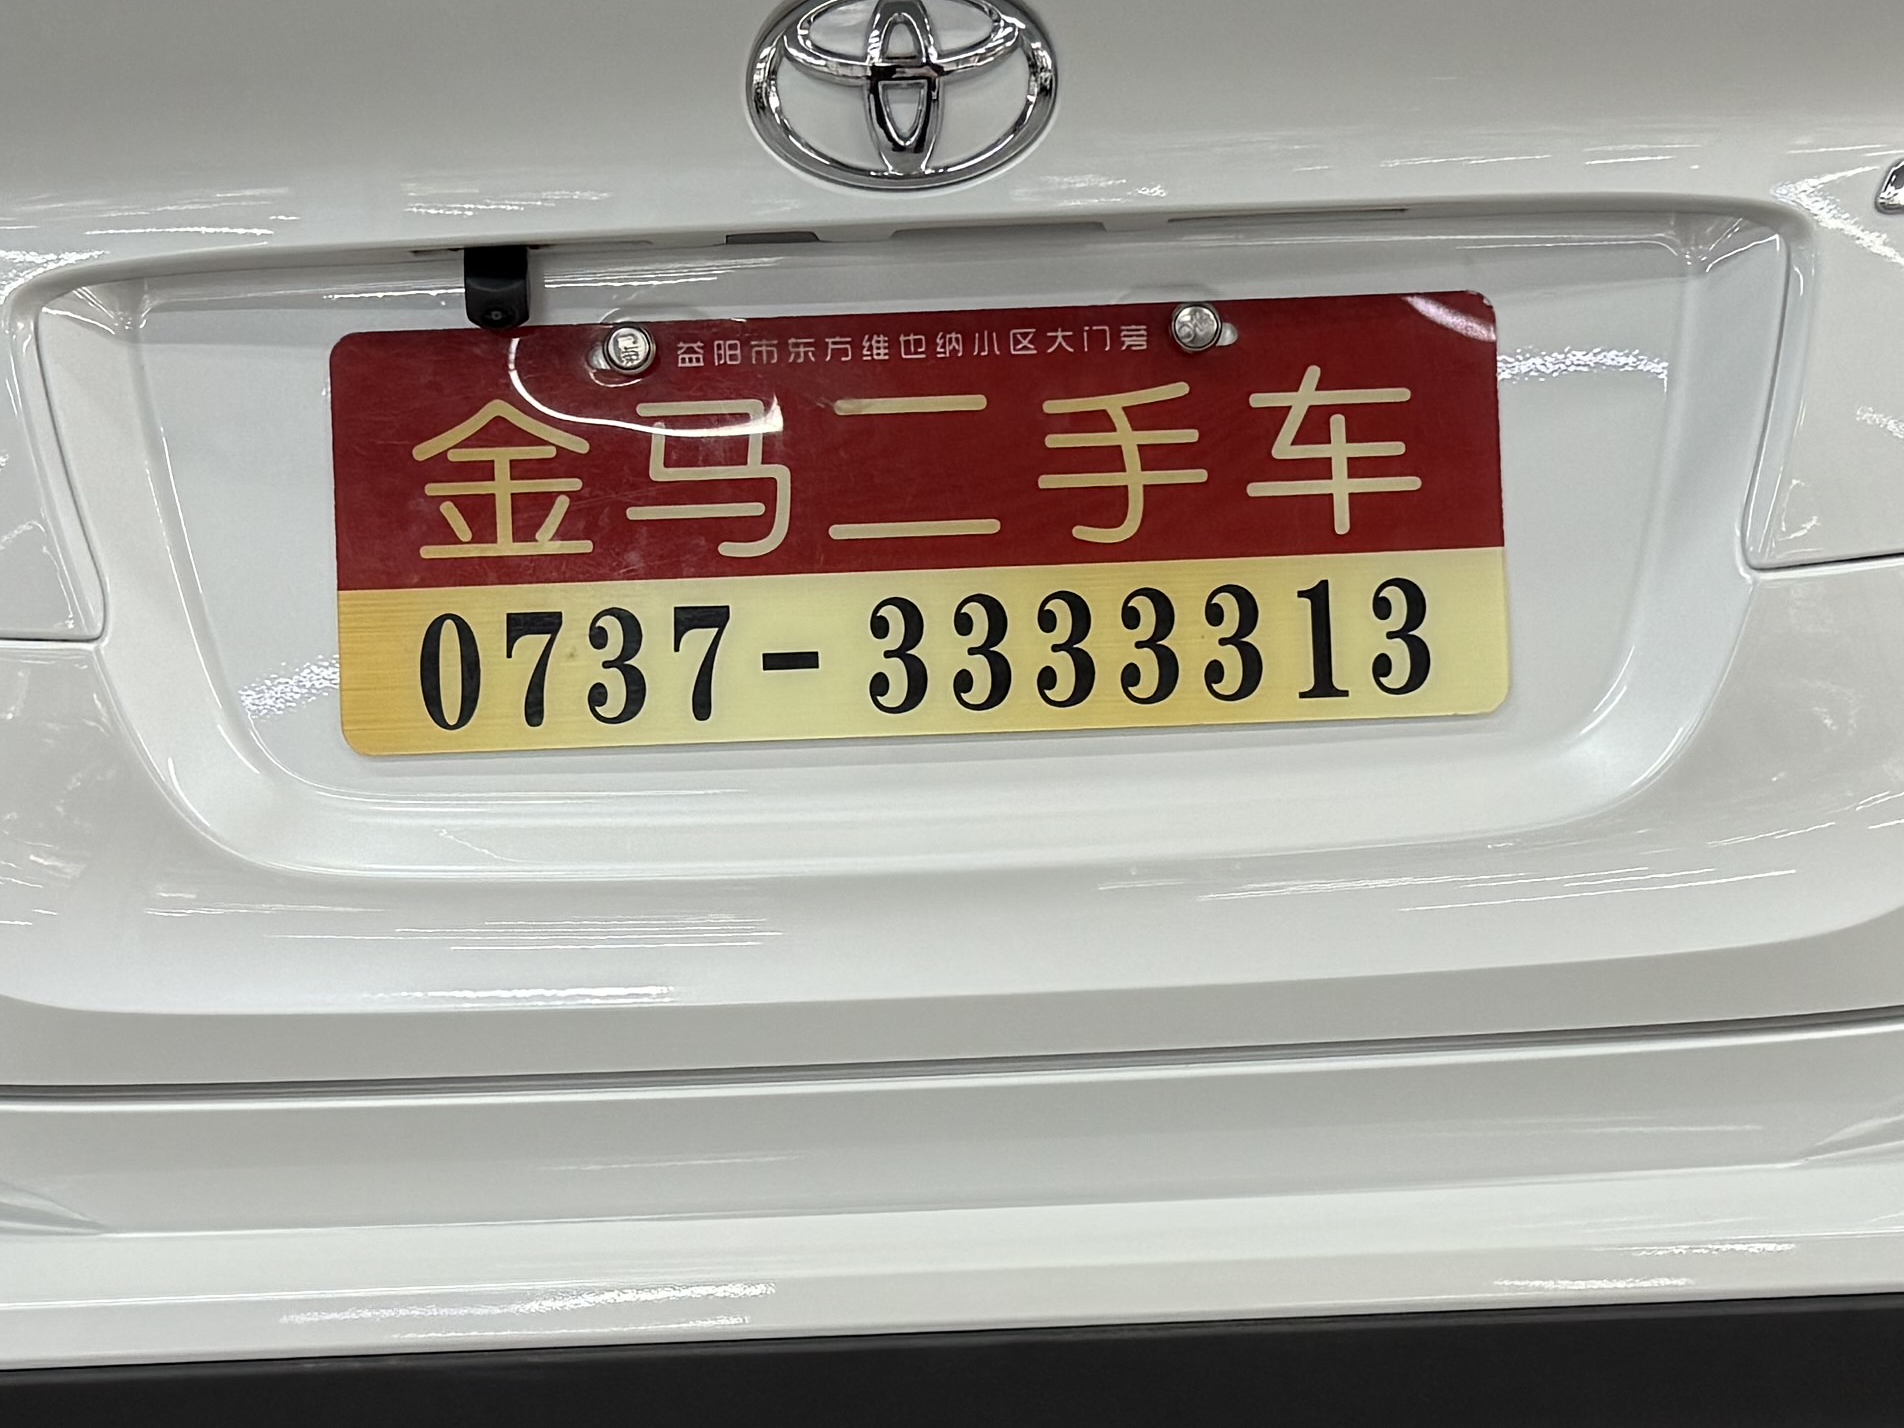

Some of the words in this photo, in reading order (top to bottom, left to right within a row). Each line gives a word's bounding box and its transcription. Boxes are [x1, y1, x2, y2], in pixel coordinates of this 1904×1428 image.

[676, 324, 1148, 368] 益阳市东方维也纳小区大门旁
[411, 364, 1424, 560] 金马二手车
[418, 576, 1434, 732] 0737-3333313
